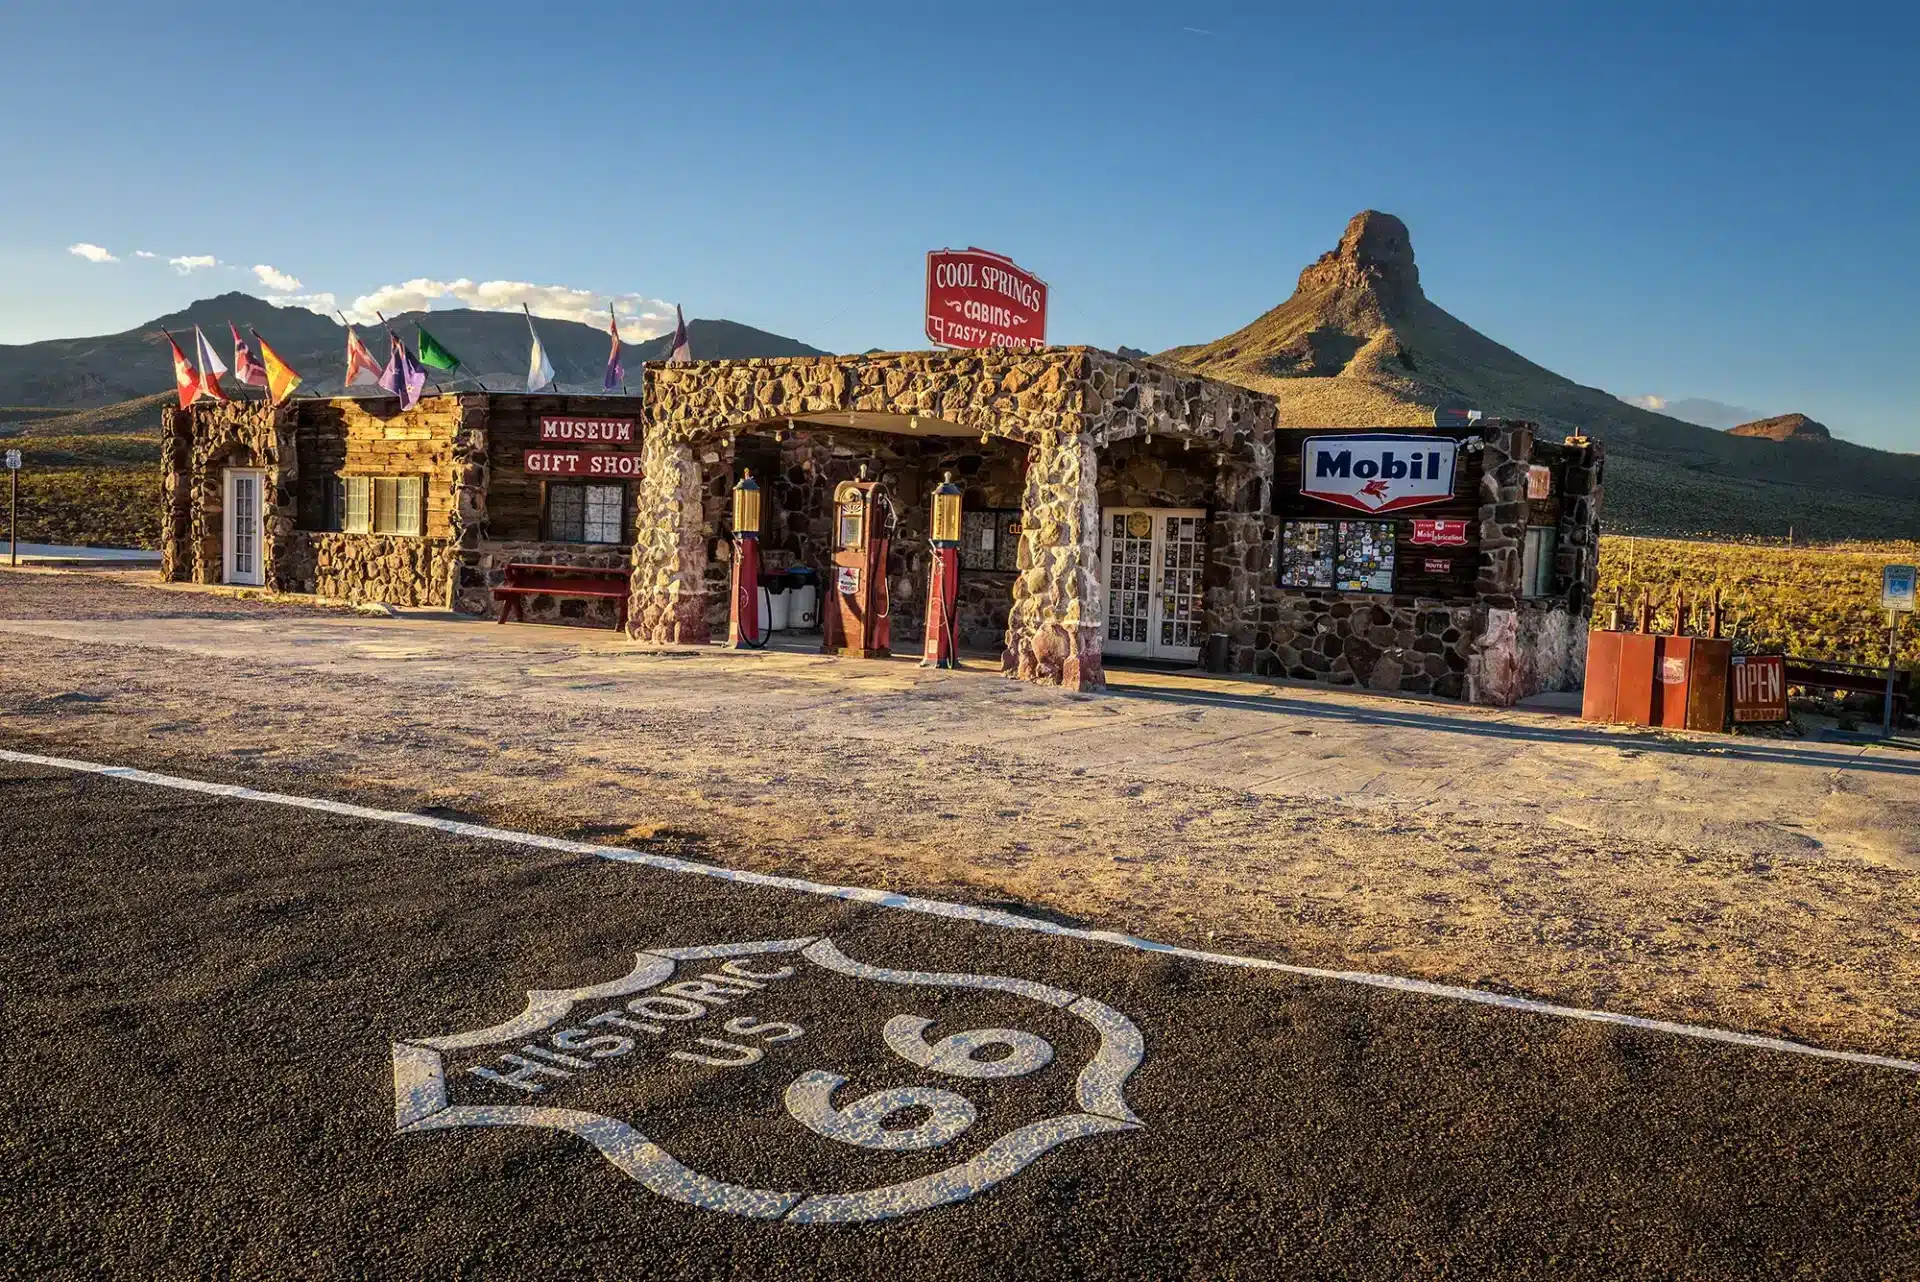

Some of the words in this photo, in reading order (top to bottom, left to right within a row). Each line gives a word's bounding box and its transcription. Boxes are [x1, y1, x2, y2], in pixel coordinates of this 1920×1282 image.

[936, 262, 978, 289] COOL
[981, 265, 1041, 313] SPRINGS
[964, 300, 1011, 329] CABINS
[947, 322, 987, 344] TASTY
[543, 420, 631, 440] MUSEUM
[527, 453, 579, 472] GIFT
[1315, 450, 1441, 480] Mobil
[1736, 663, 1781, 703] OPEN
[467, 959, 795, 1093] HISTORIC
[671, 1016, 806, 1066] US
[785, 1014, 1054, 1151] 66
